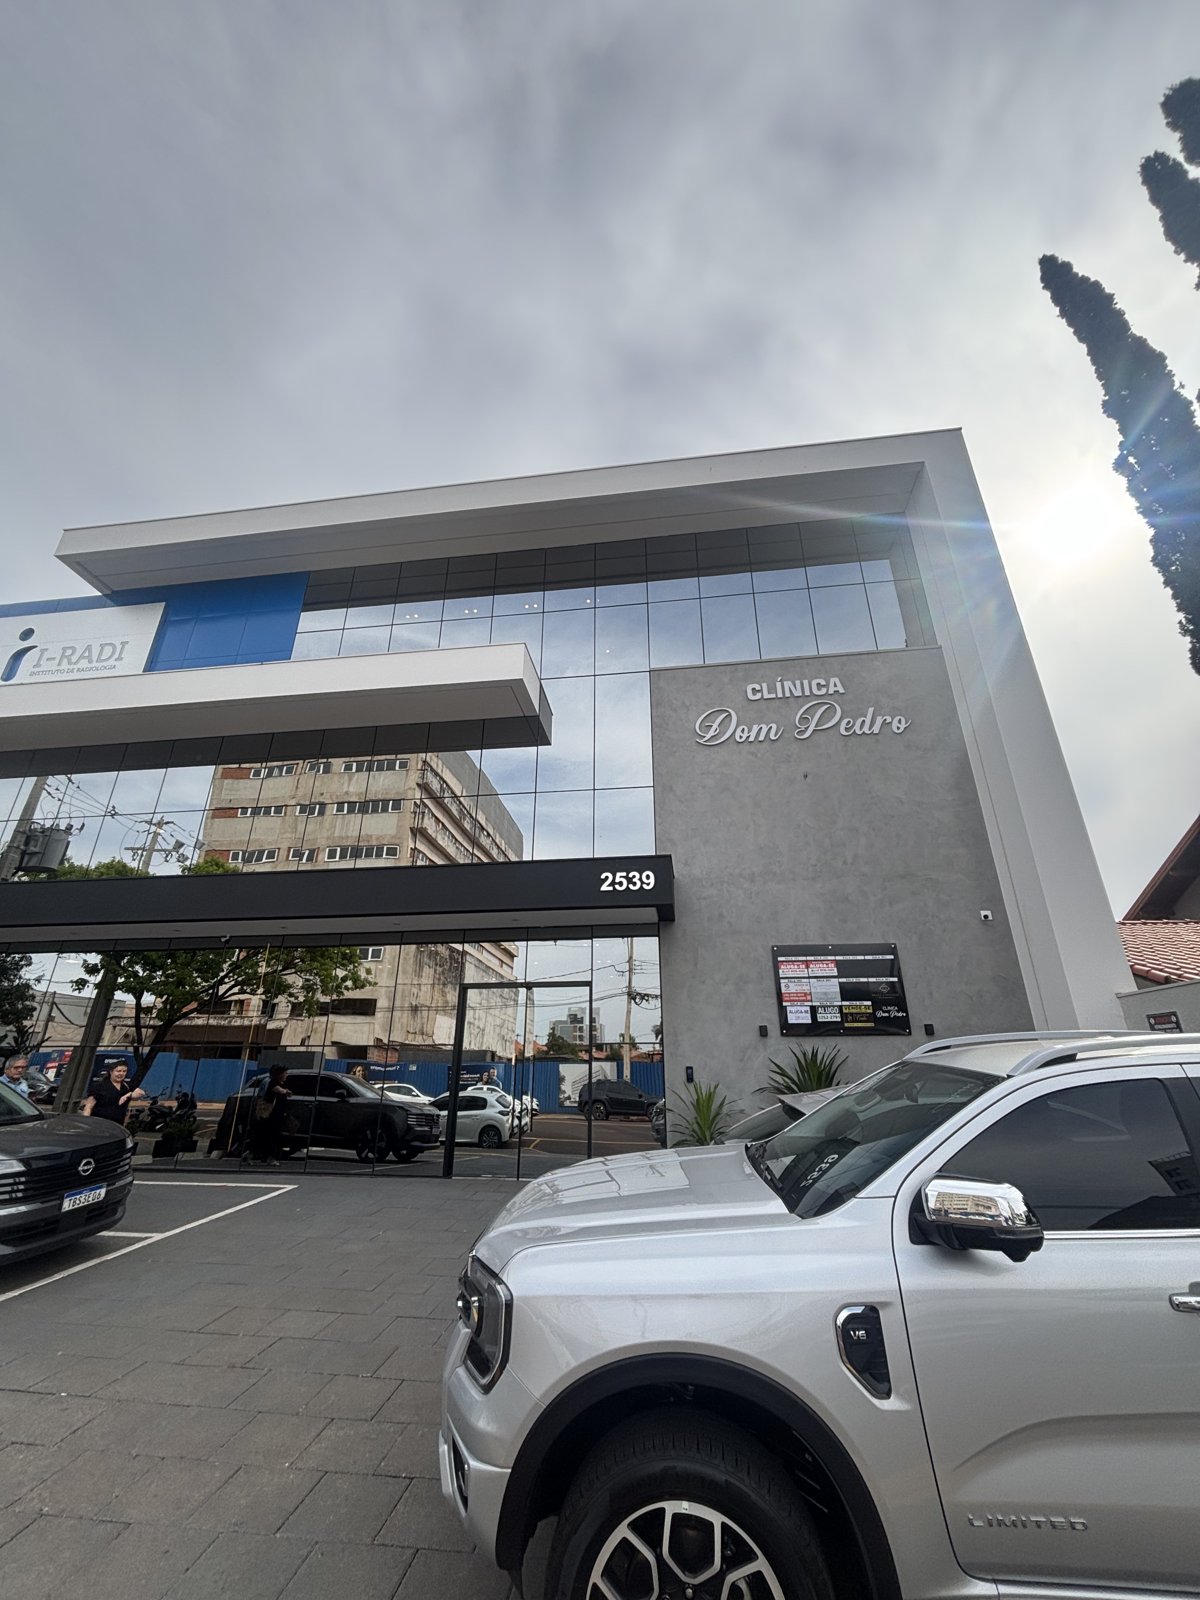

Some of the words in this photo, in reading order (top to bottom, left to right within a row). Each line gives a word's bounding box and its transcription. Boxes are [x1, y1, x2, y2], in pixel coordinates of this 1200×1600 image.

[33, 641, 129, 669] I-RADI
[29, 668, 65, 677] INSTITUTO
[76, 664, 116, 673] RADIOLOGIA
[746, 677, 845, 701] CLÍNICA
[694, 707, 784, 746] Dom
[793, 700, 912, 740] Pedro
[600, 870, 655, 891] 2539
[850, 1330, 866, 1340] V6
[967, 1512, 1088, 1532] LIMITED
